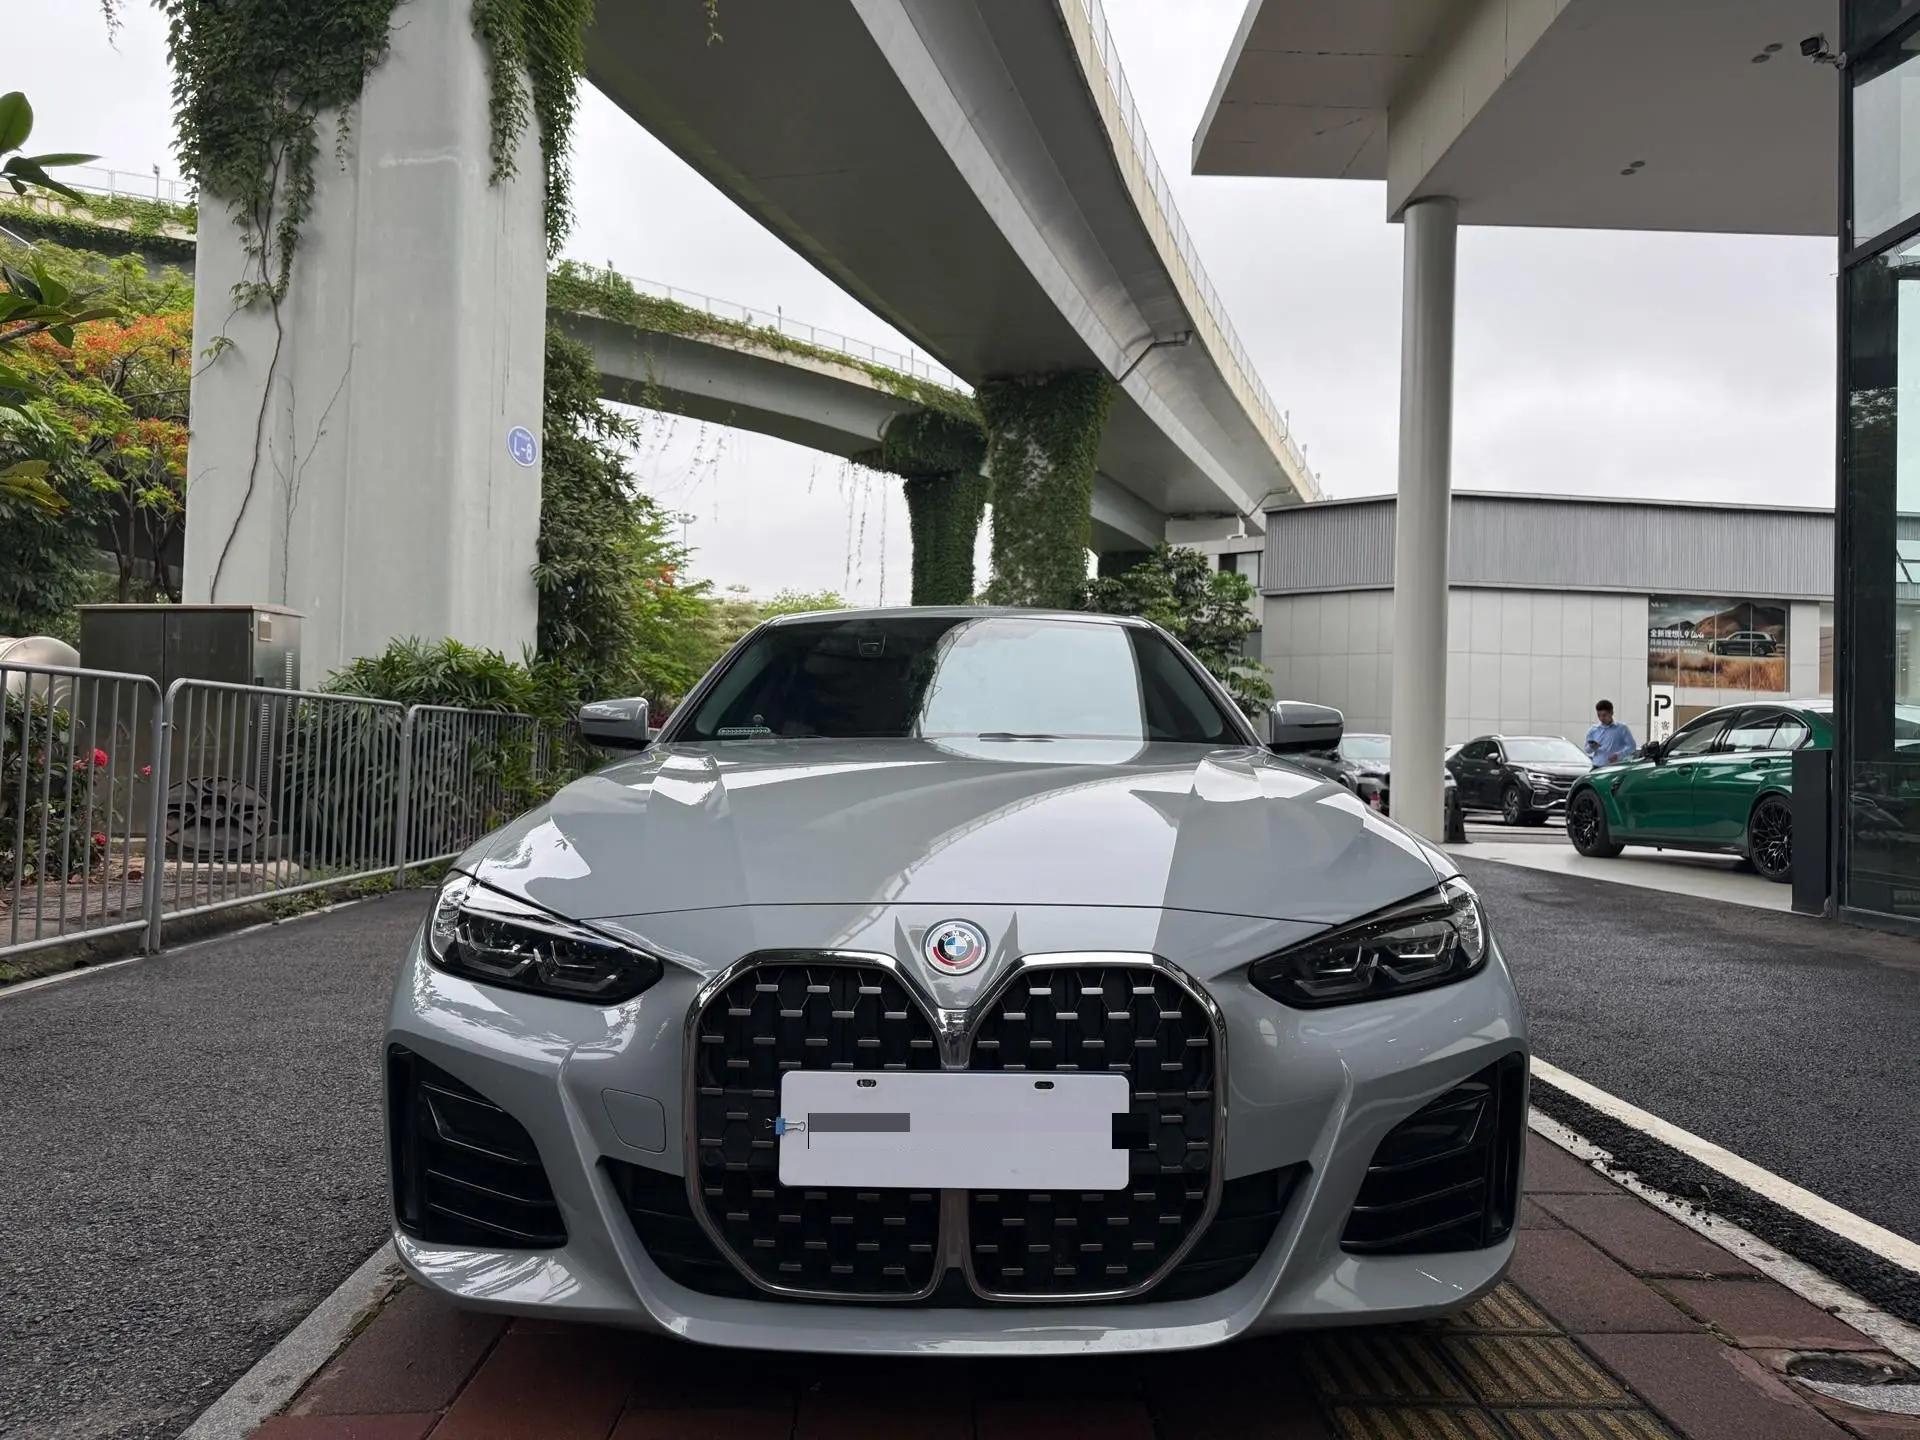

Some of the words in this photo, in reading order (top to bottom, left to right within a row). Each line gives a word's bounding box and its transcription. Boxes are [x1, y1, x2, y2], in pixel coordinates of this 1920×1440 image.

[514, 436, 533, 461] L-8
[1654, 694, 1672, 717] P
[941, 930, 971, 942] BMW
